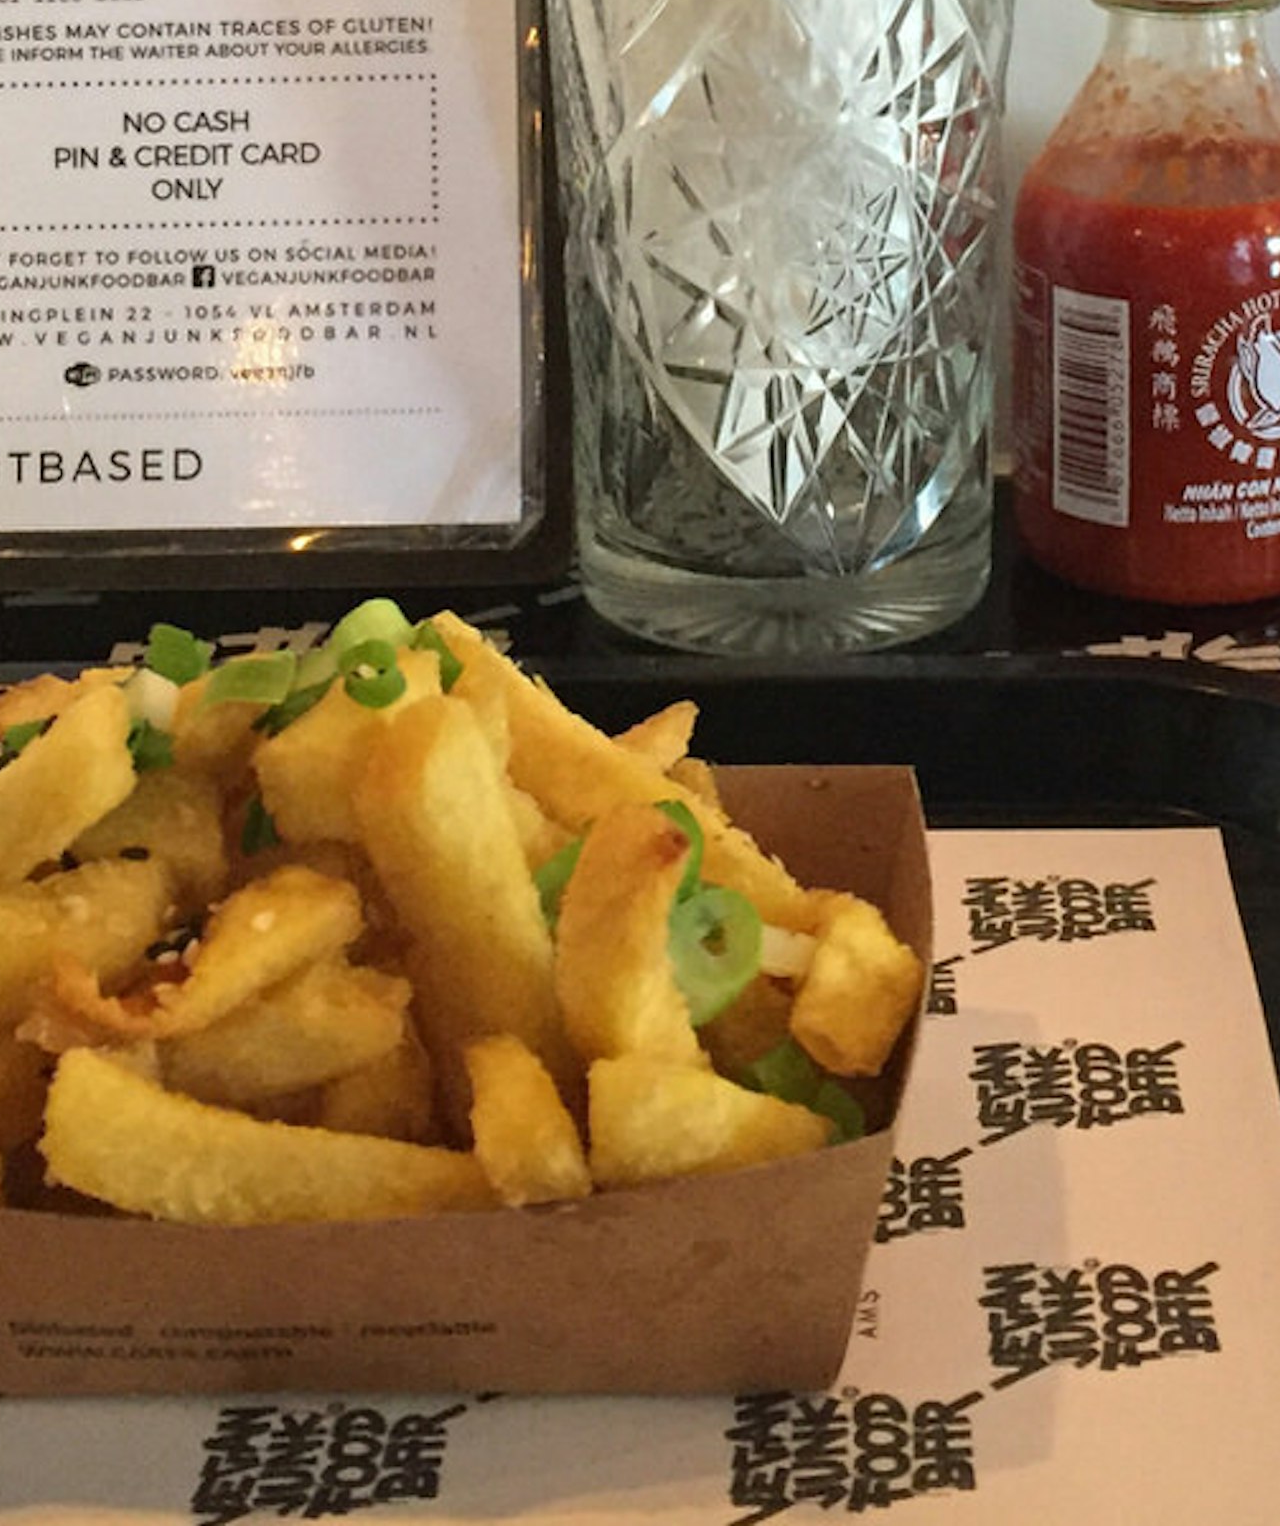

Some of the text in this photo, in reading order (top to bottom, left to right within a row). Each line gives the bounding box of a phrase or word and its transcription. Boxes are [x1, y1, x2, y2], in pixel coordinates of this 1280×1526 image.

[65, 23, 110, 40] MAY
[118, 21, 212, 39] CONTAIN
[220, 20, 300, 37] TRACES
[308, 19, 336, 36] OF
[343, 17, 434, 35] GLUTEN!
[11, 45, 83, 62] INFORM
[90, 44, 124, 61] THE
[130, 42, 200, 60] WAITER
[205, 41, 269, 58] ABOUT
[275, 40, 325, 56] YOUR
[123, 110, 249, 134] NO CASH
[54, 142, 320, 169] PIN & CREDIT CARD
[151, 178, 224, 201] ONLY
[10, 251, 86, 268] FORGET
[95, 250, 118, 266] TO
[128, 248, 206, 265] FOLLOW
[214, 247, 240, 263] US
[248, 246, 277, 263] ON
[286, 244, 355, 262] SOCIAL
[223, 267, 436, 286] VEGANJUNKFOODBAR
[127, 306, 151, 321] 22
[289, 301, 436, 318] AMSTERDAM
[1023, 1043, 1075, 1127] JUNK
[1076, 1042, 1125, 1129] FOOD
[1125, 1041, 1186, 1115] BAR
[1039, 1267, 1099, 1369] JUNK
[1100, 1264, 1163, 1371] FOOD
[1154, 1262, 1220, 1353] BAR
